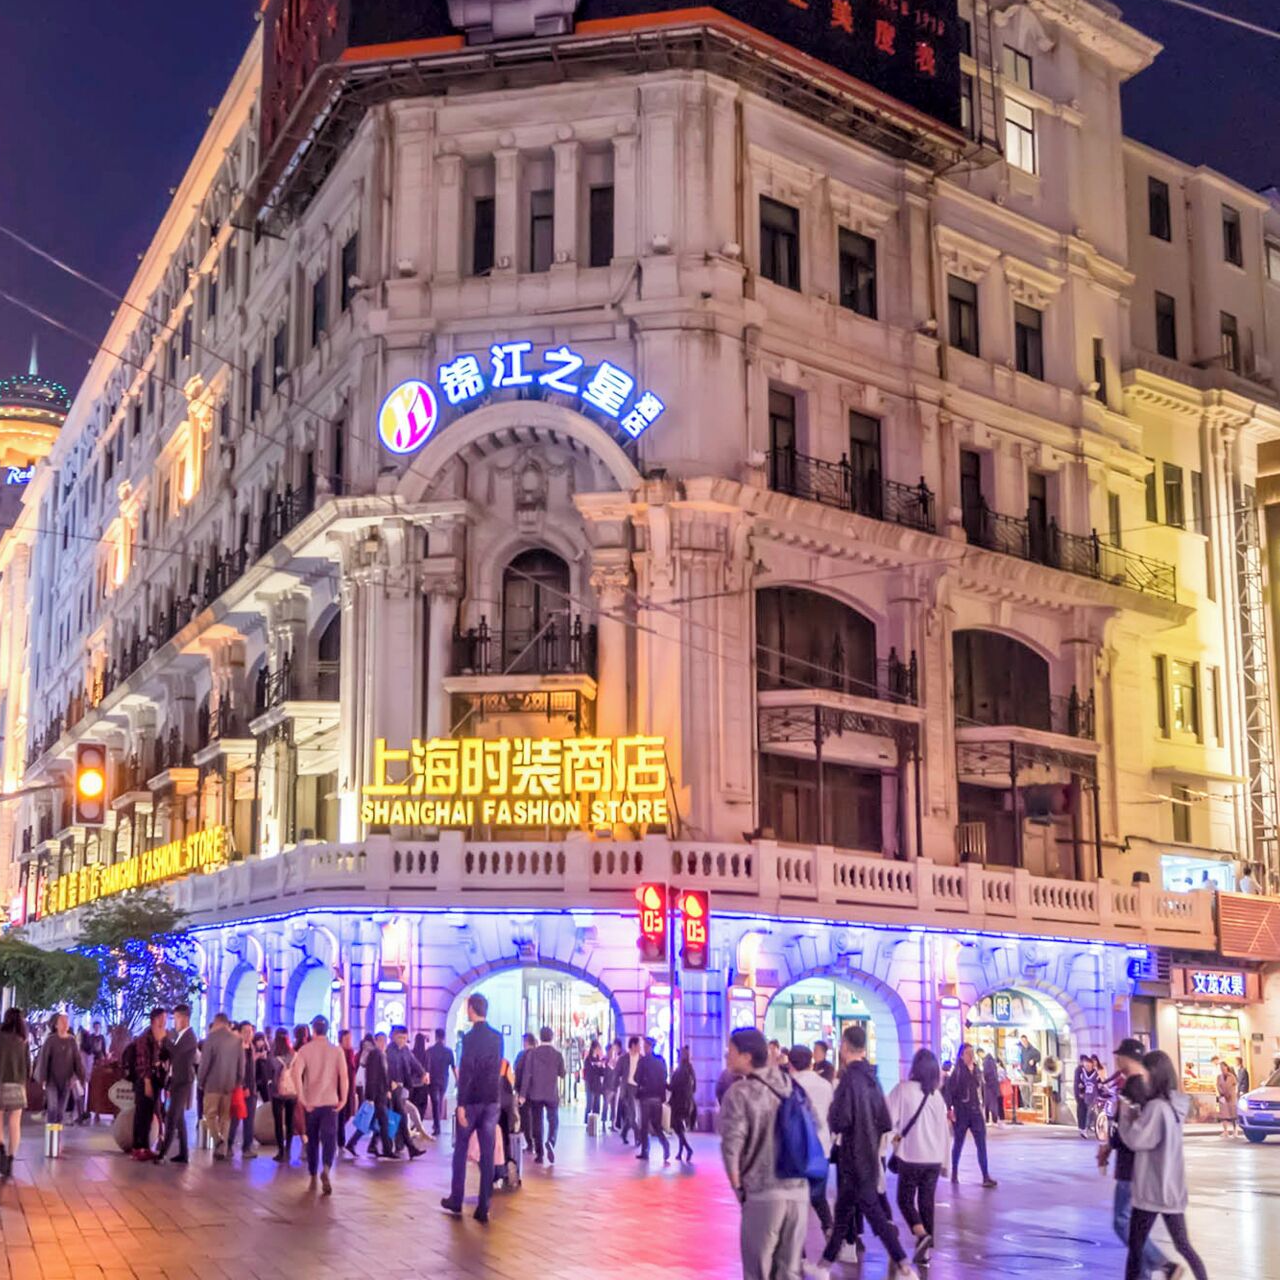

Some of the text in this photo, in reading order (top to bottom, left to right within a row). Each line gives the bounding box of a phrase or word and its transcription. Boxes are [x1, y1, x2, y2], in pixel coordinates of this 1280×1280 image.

[438, 341, 635, 418] 锦江之星
[361, 736, 667, 795] 上海时装商店
[360, 798, 668, 824] SHANGHAI FASHION STORE
[100, 856, 139, 896] SHANGHAI
[140, 839, 183, 884] FASHION
[185, 825, 224, 865] STORE
[643, 910, 664, 933] 03
[686, 919, 706, 943] 03
[1193, 971, 1245, 996] 文龙水果
